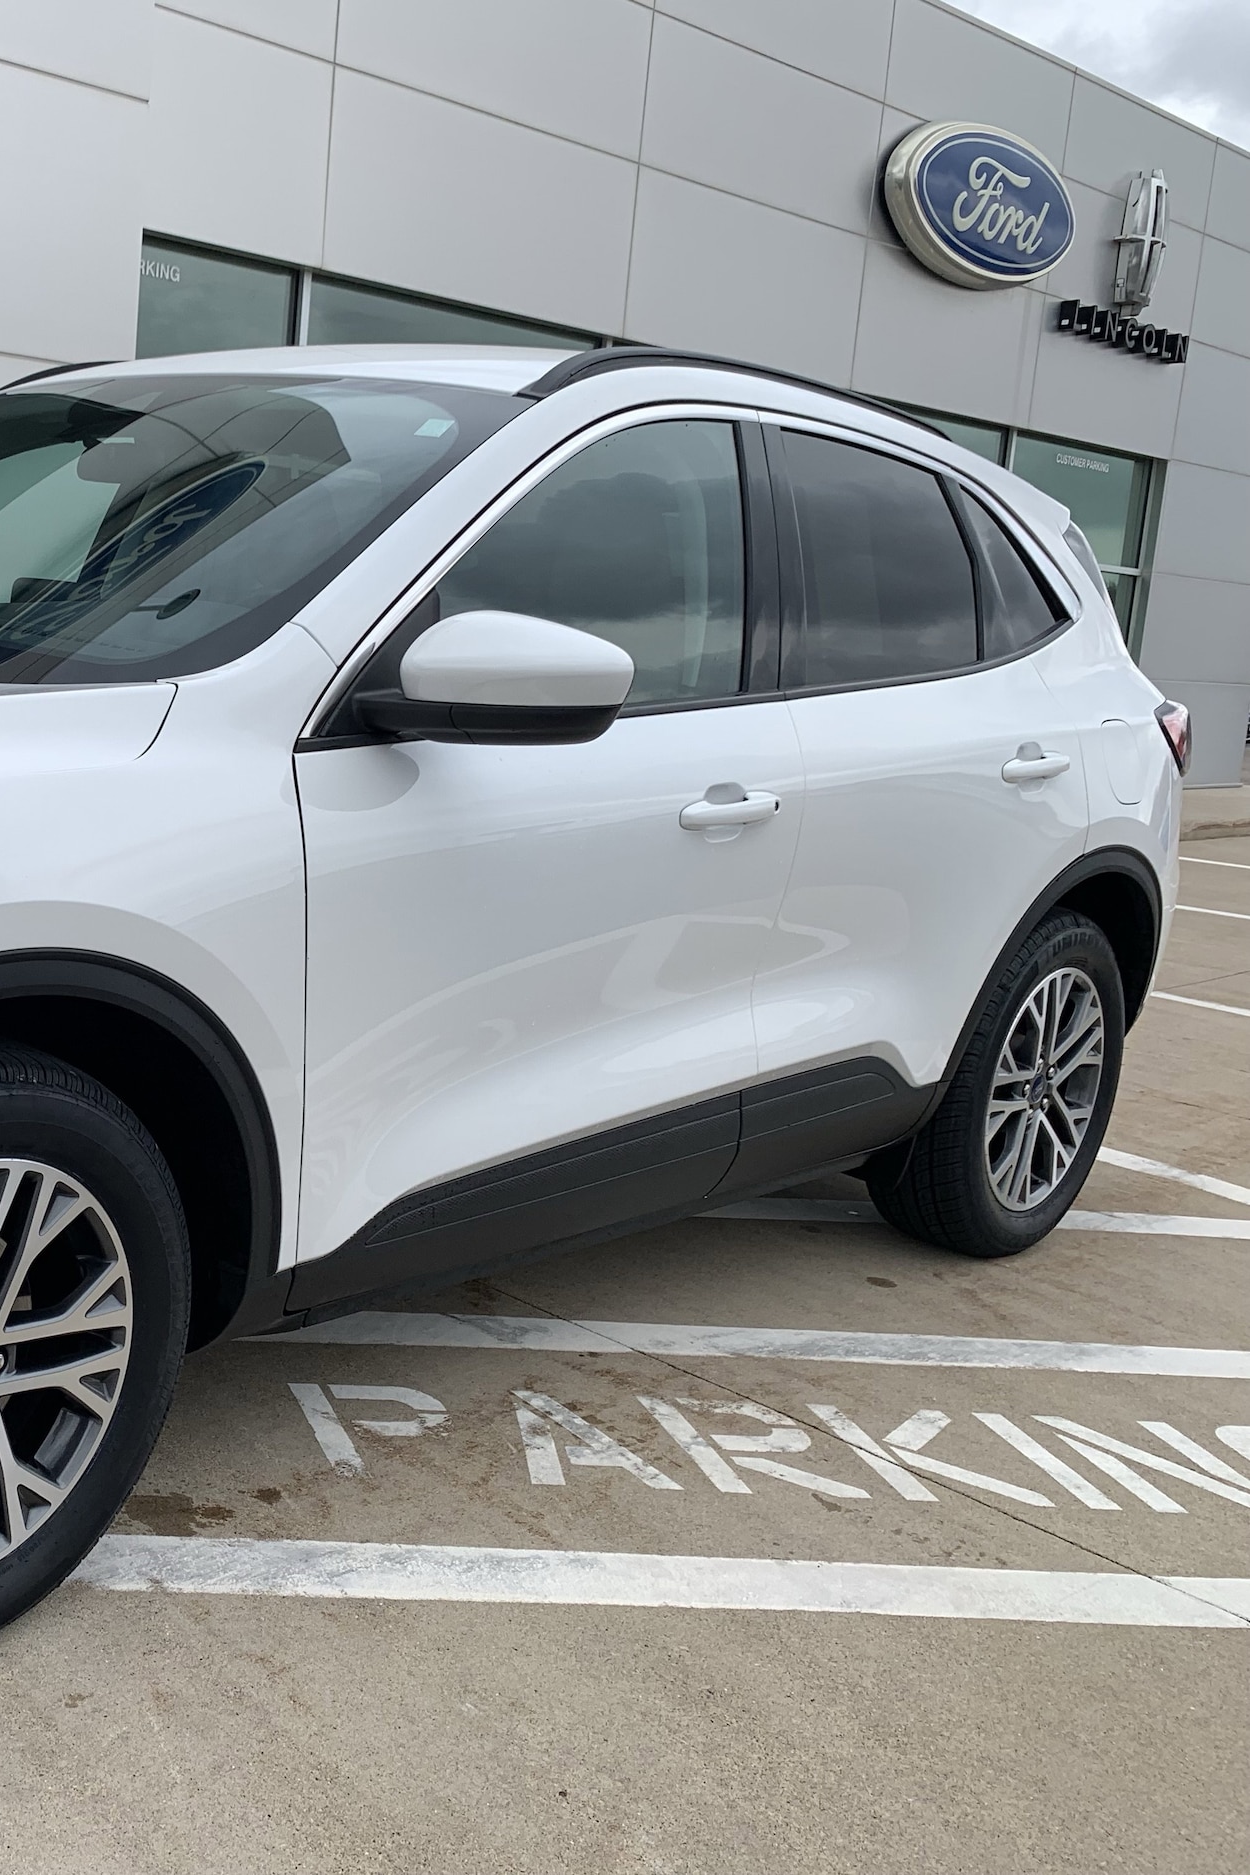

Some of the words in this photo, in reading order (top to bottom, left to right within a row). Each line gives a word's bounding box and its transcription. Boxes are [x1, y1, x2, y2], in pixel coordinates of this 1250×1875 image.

[953, 156, 1050, 255] Ford
[1059, 299, 1189, 364] LINCOLN
[1056, 453, 1086, 469] CUSTOMER
[1086, 459, 1109, 473] PARKING
[287, 1382, 1250, 1514] PARKIN
